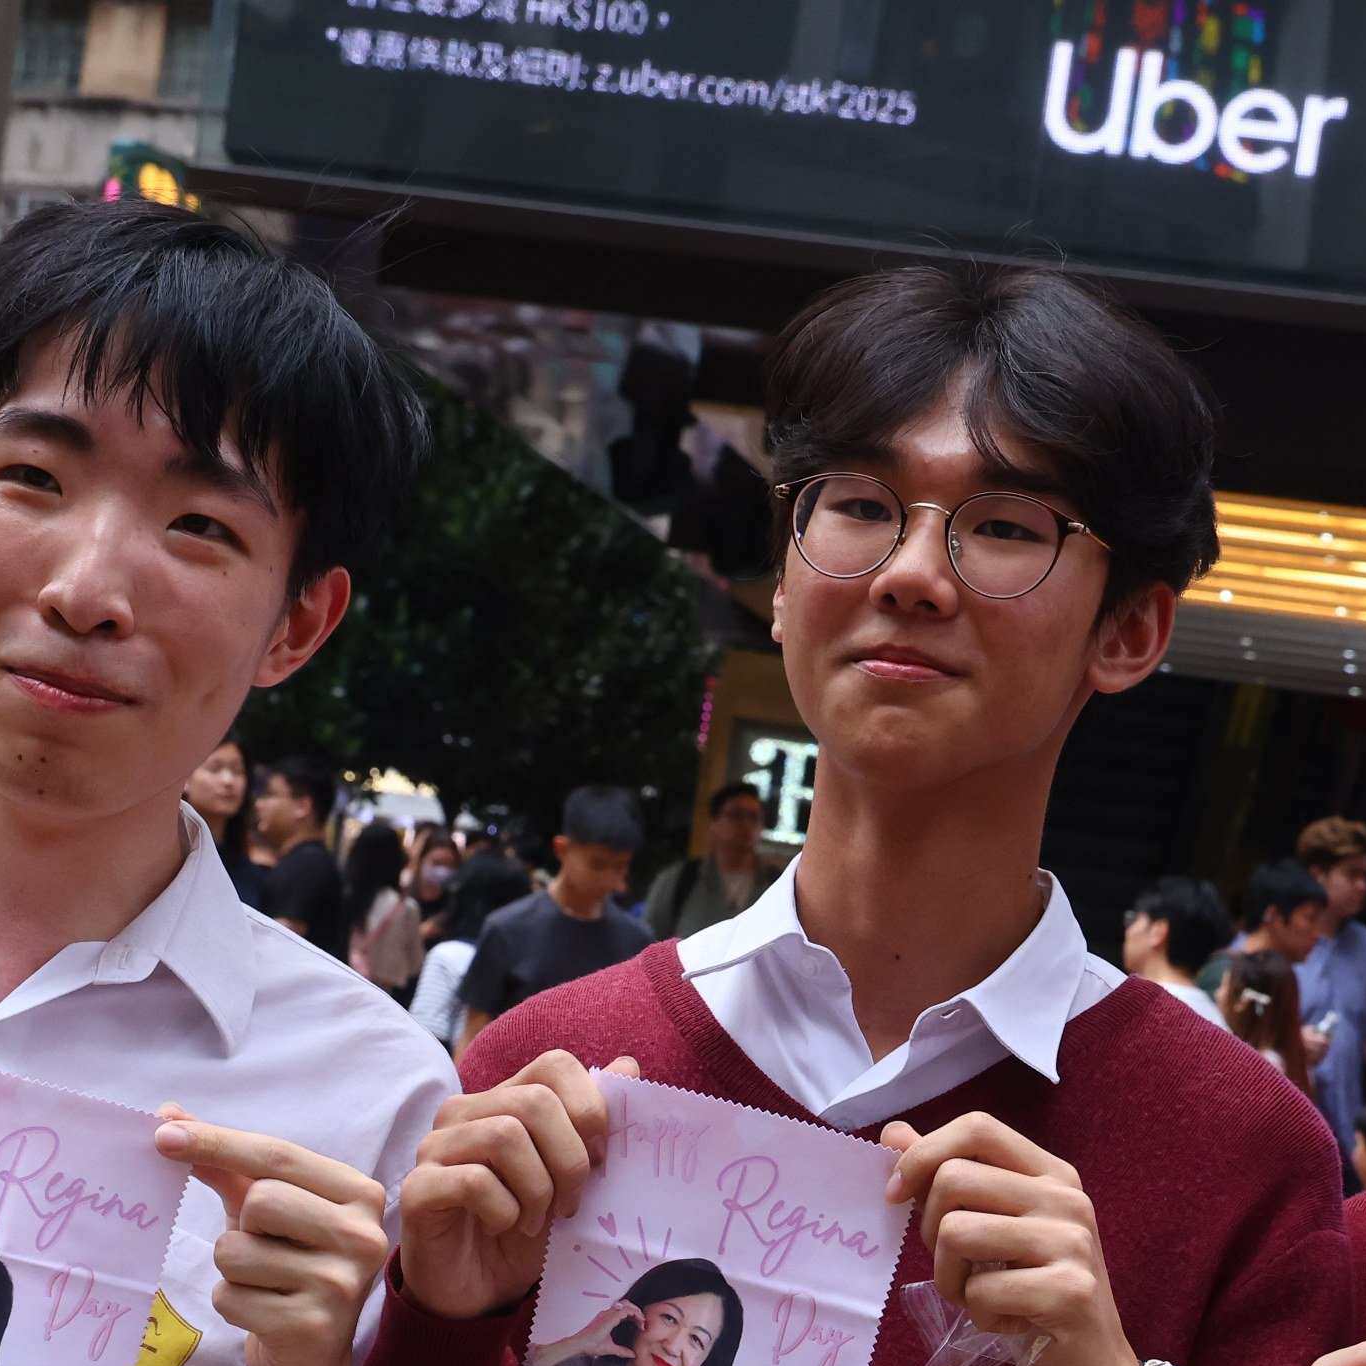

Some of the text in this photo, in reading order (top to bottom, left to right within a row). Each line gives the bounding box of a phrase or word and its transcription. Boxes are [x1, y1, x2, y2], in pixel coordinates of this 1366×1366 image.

[1043, 39, 1348, 178] Uber
[716, 1155, 881, 1279] Regina
[43, 1262, 134, 1362] Day
